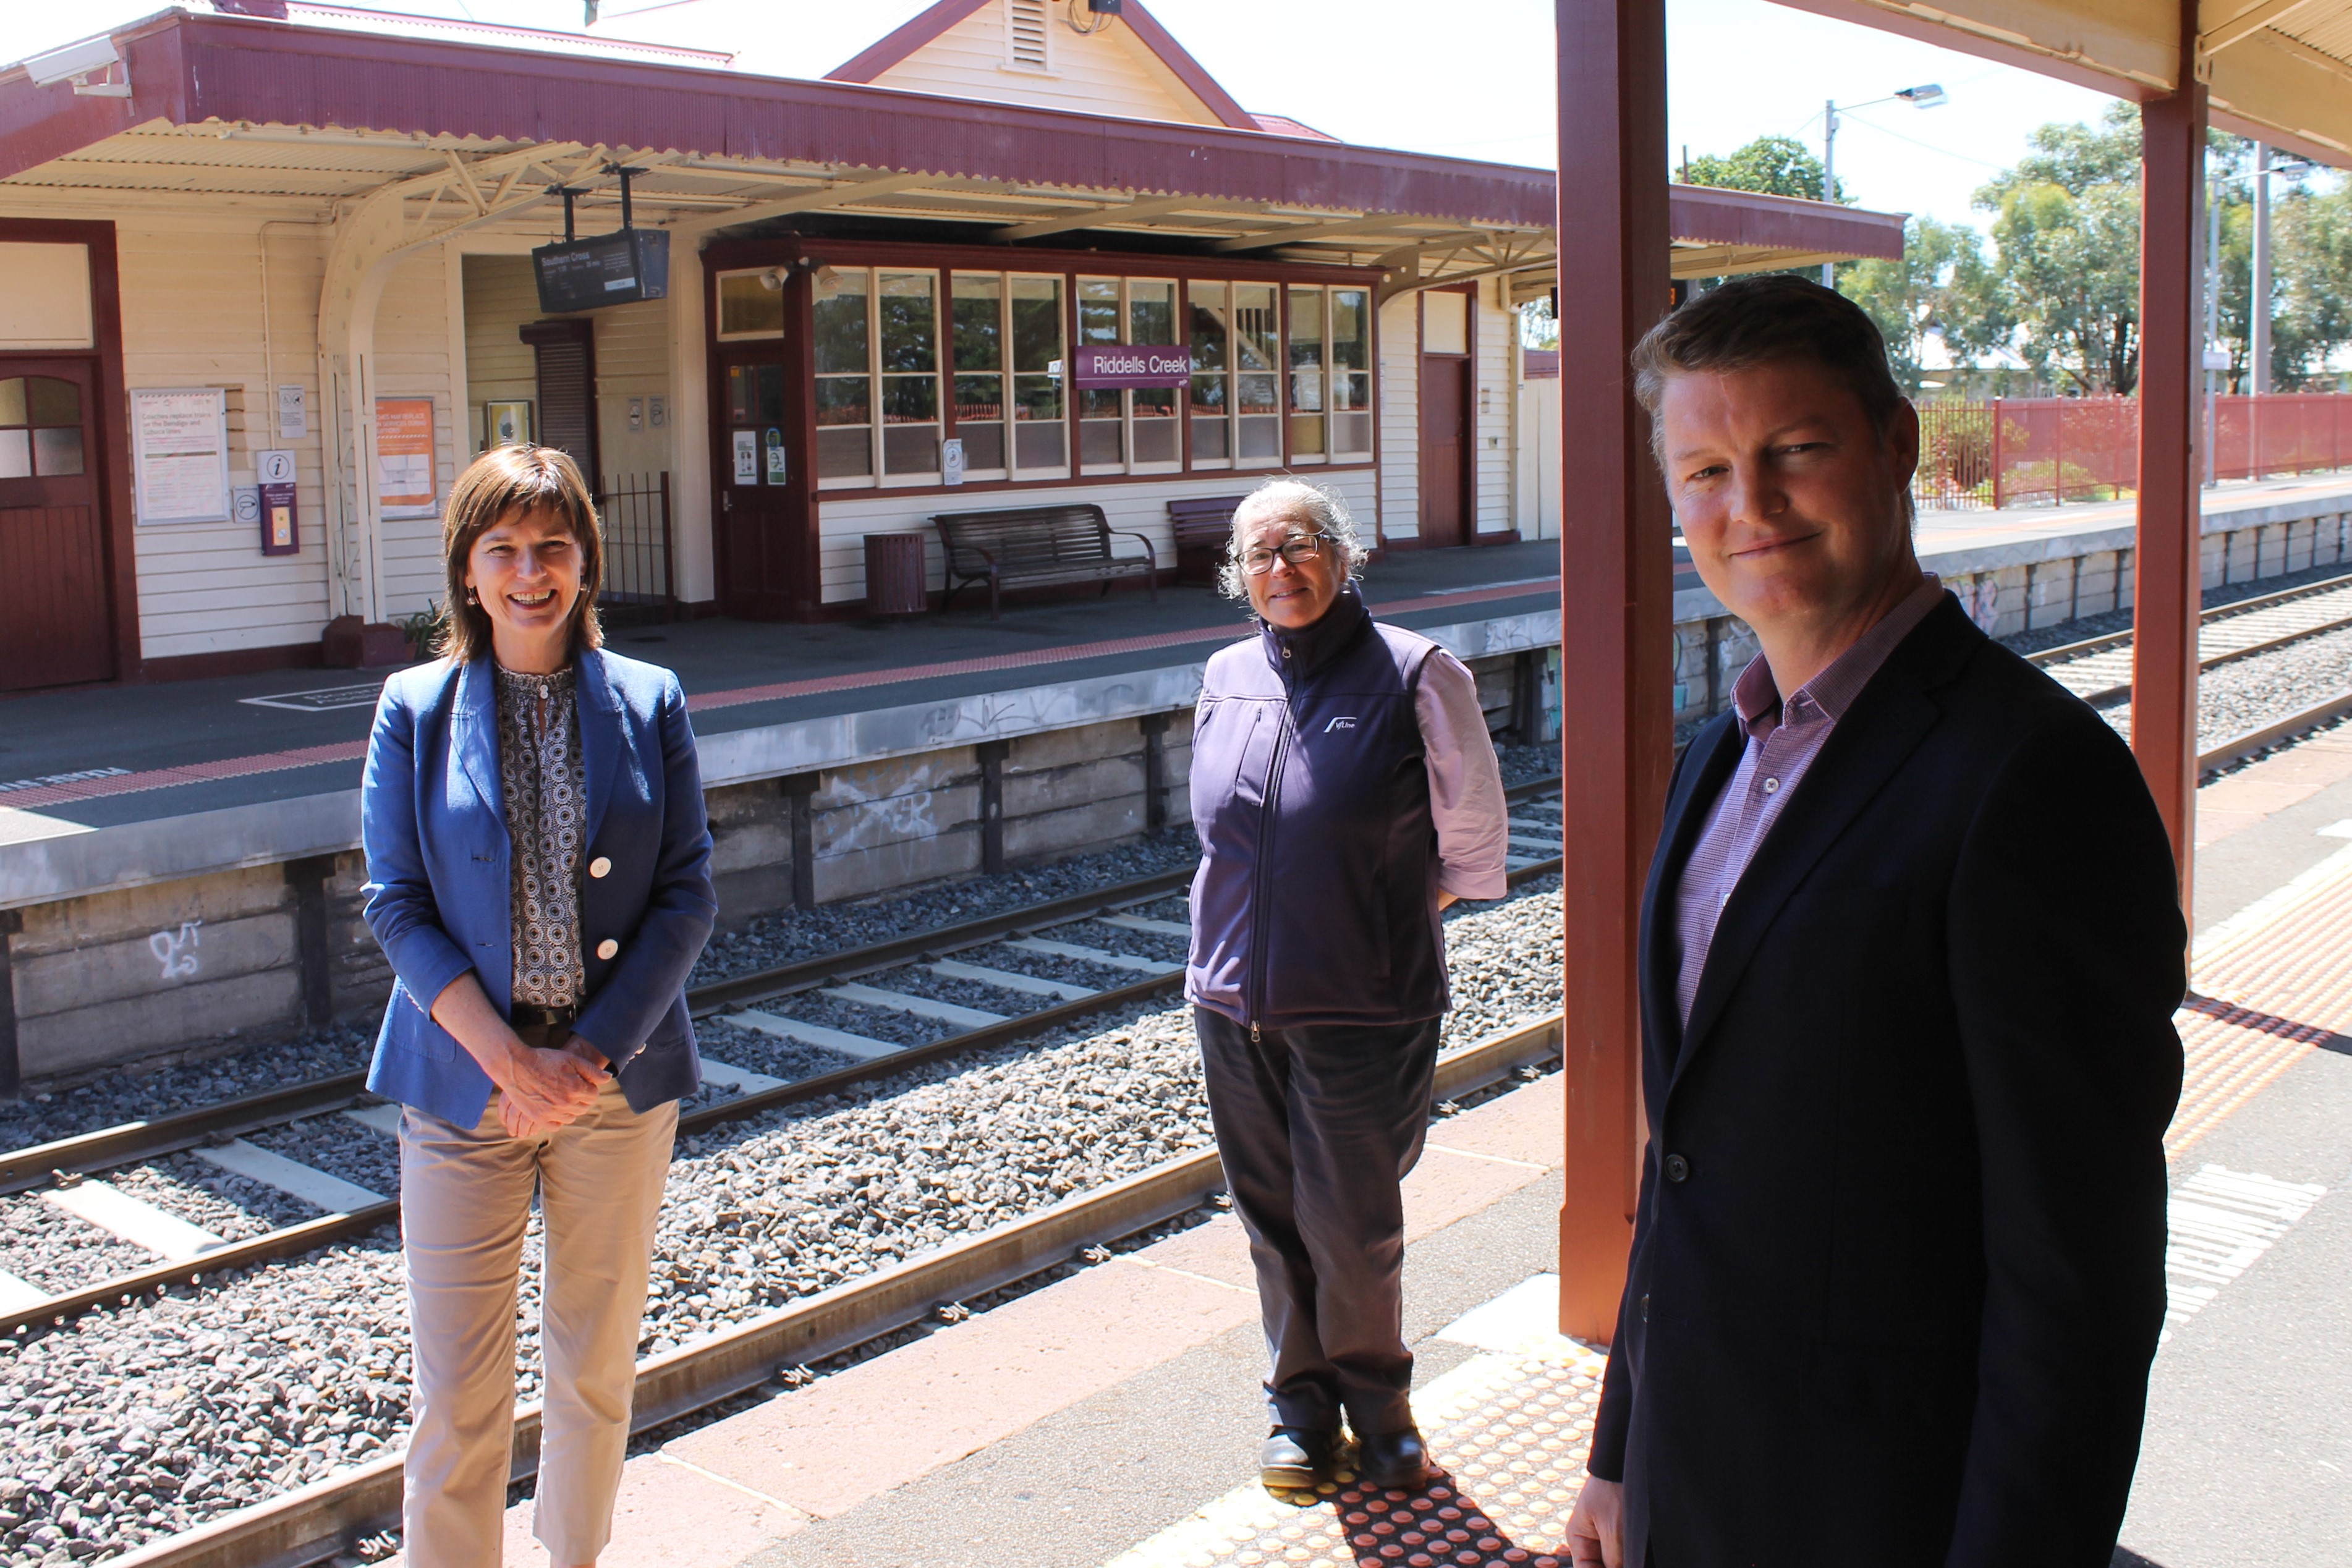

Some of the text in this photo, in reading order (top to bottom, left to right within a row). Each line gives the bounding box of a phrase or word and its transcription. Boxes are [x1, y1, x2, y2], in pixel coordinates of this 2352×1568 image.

[541, 252, 590, 266] Southern Cross
[1093, 355, 1187, 374] Riddells Creek
[1336, 720, 1355, 730] V/Line
[2172, 1163, 2328, 1221] LINE
